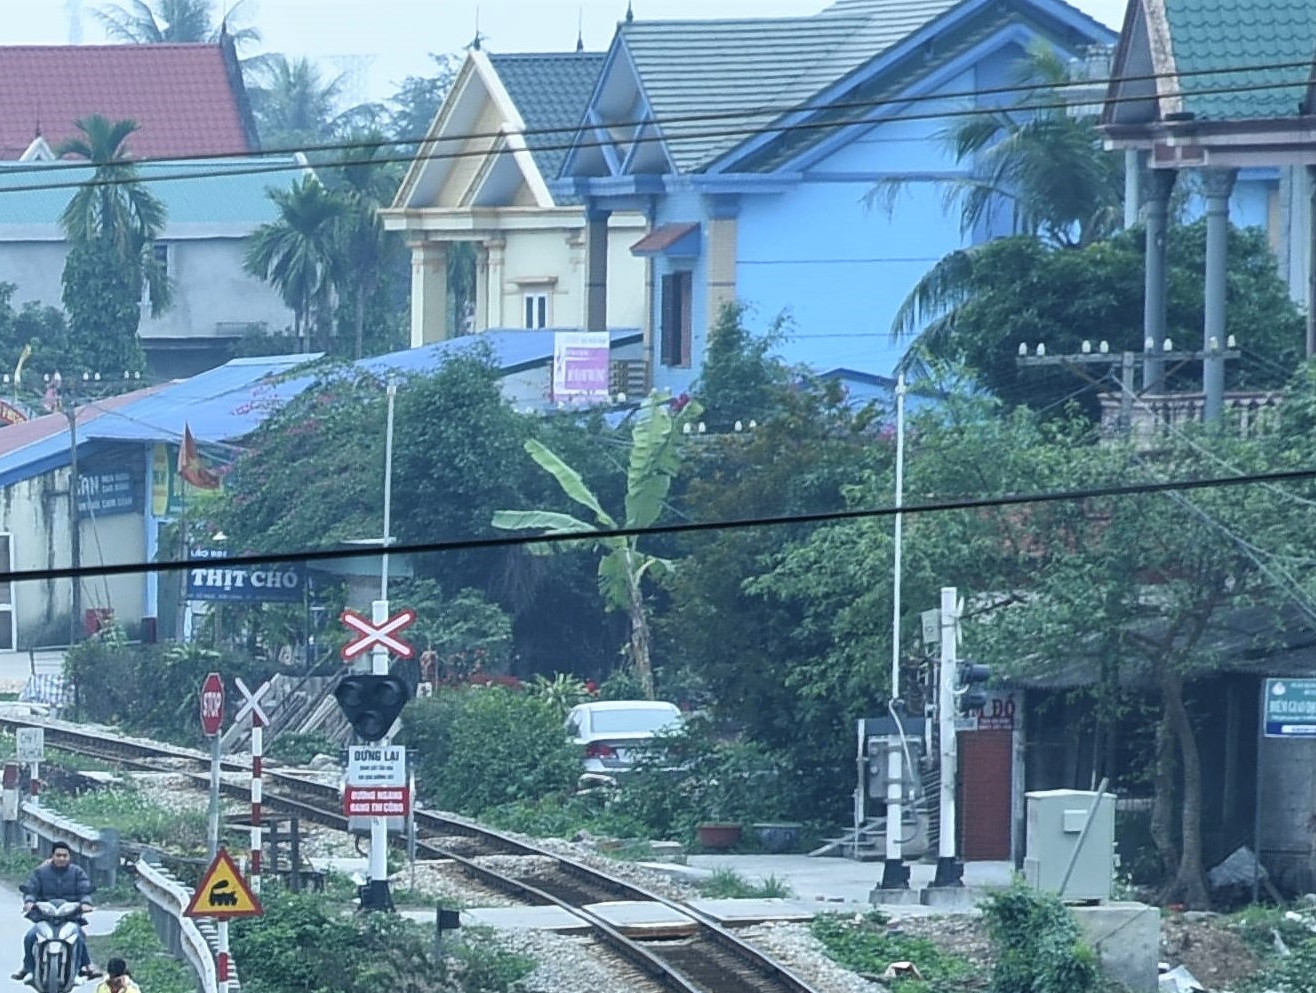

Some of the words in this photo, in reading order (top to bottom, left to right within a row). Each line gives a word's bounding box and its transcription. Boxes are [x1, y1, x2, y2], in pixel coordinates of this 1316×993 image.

[191, 568, 248, 591] THỊT
[250, 565, 298, 588] CHÓ
[204, 691, 222, 717] STOP
